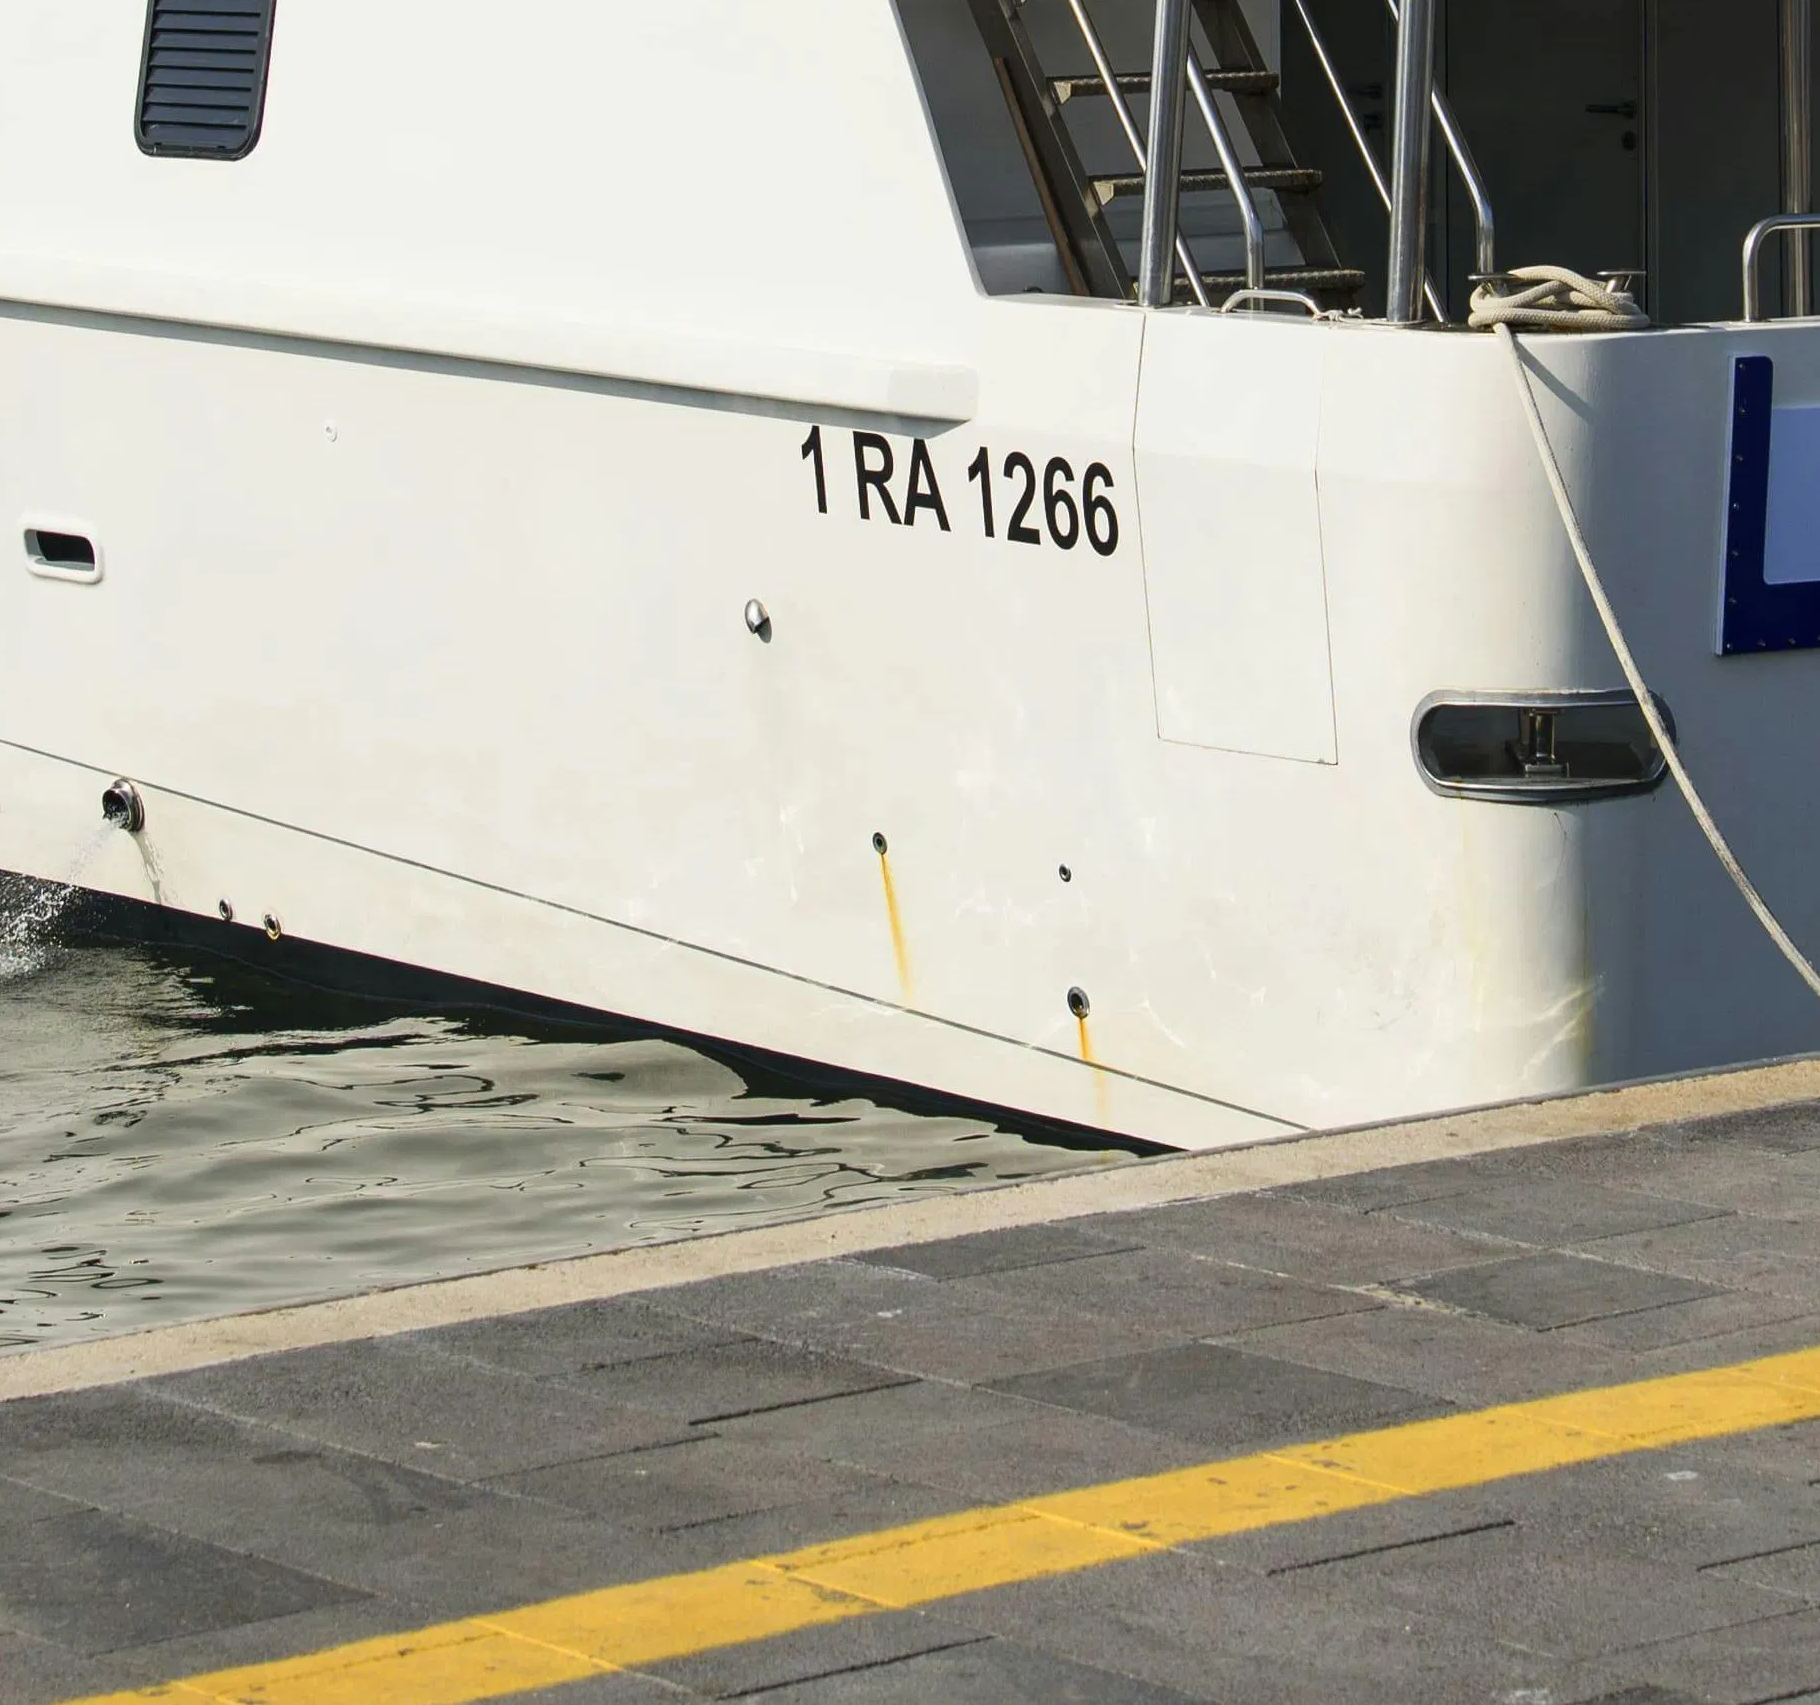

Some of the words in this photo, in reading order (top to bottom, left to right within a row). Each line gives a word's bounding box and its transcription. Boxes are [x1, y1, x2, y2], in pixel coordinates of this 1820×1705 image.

[801, 425, 827, 514] 1
[853, 430, 951, 532] RA
[967, 446, 1119, 557] 1266
